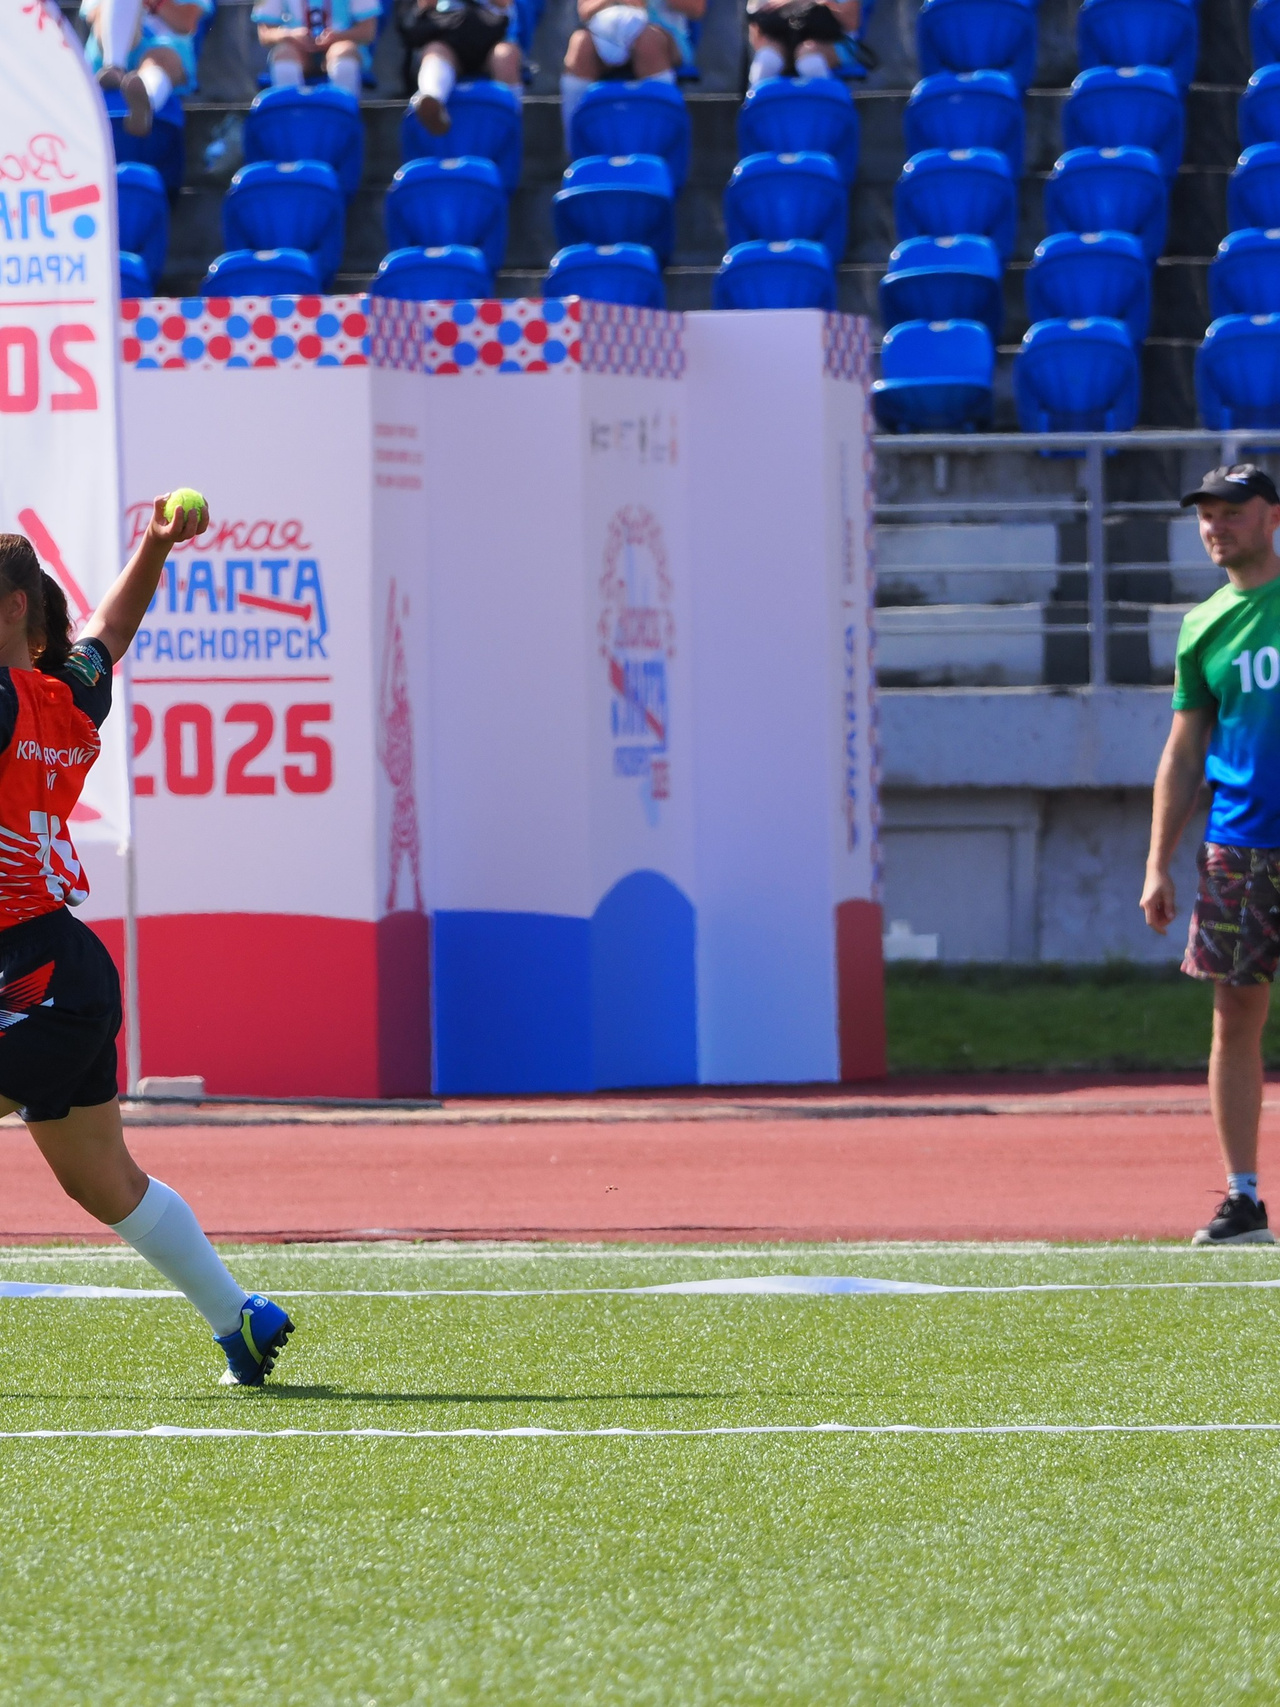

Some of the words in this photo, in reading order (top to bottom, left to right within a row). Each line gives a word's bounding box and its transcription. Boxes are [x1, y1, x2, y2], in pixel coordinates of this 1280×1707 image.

[125, 502, 312, 552] Рская
[135, 628, 329, 661] РАСНОЯРСК
[1231, 645, 1280, 694] 10
